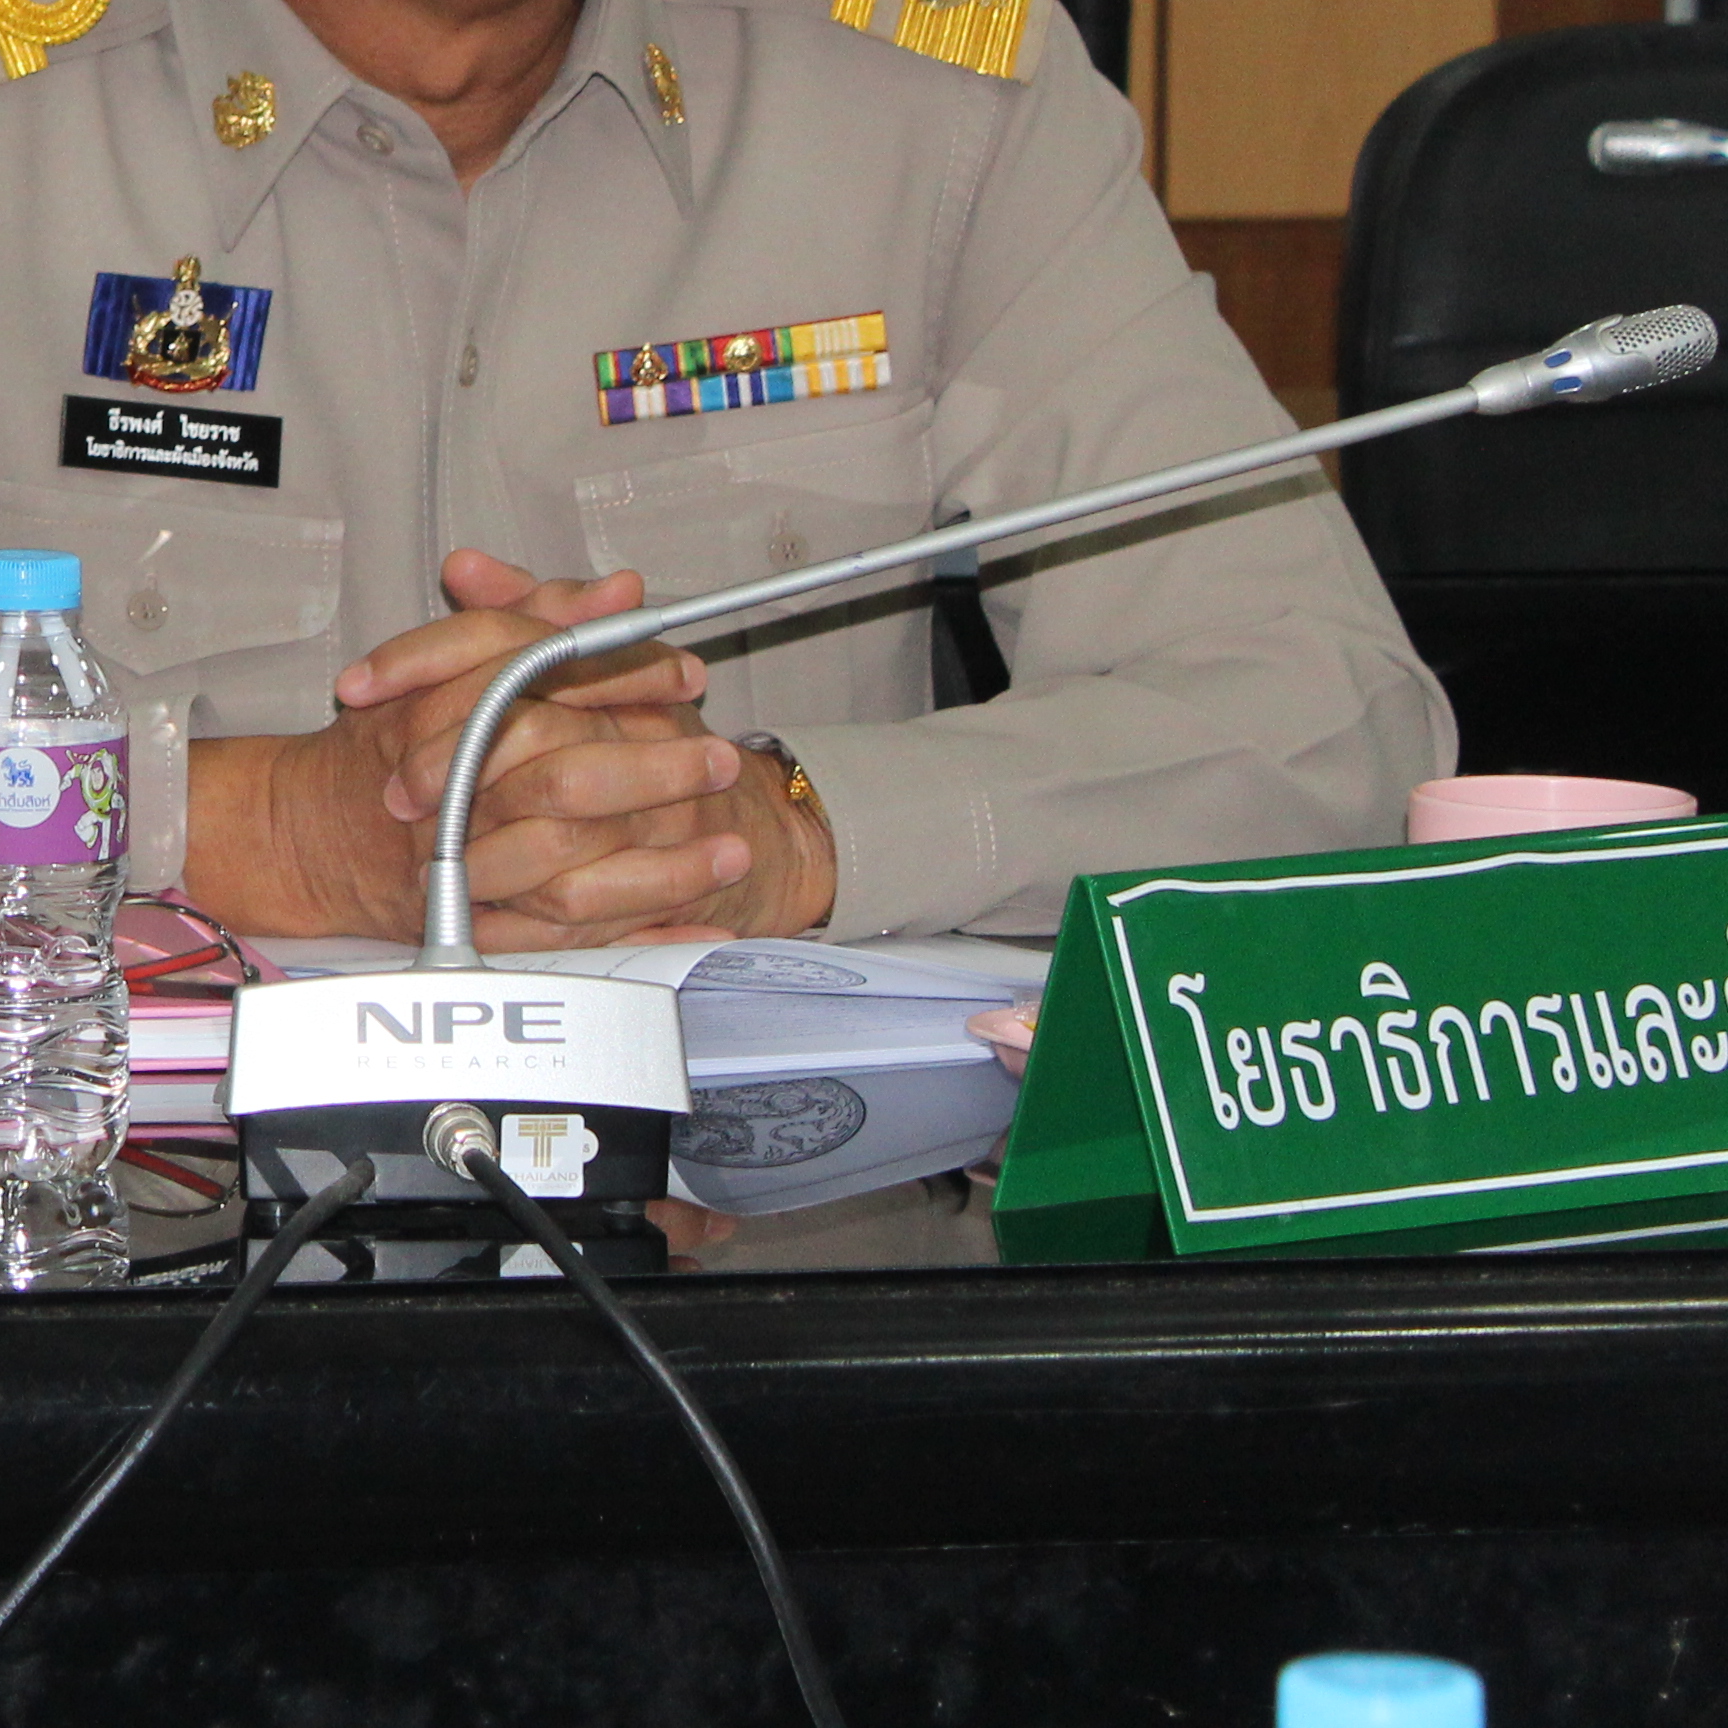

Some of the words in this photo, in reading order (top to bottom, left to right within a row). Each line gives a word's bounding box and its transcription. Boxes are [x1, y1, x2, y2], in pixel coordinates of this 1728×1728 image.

[356, 1001, 566, 1045] NPE
[357, 1055, 566, 1070] RESEARCH
[1167, 961, 1728, 1131] โยธาธิการและ
